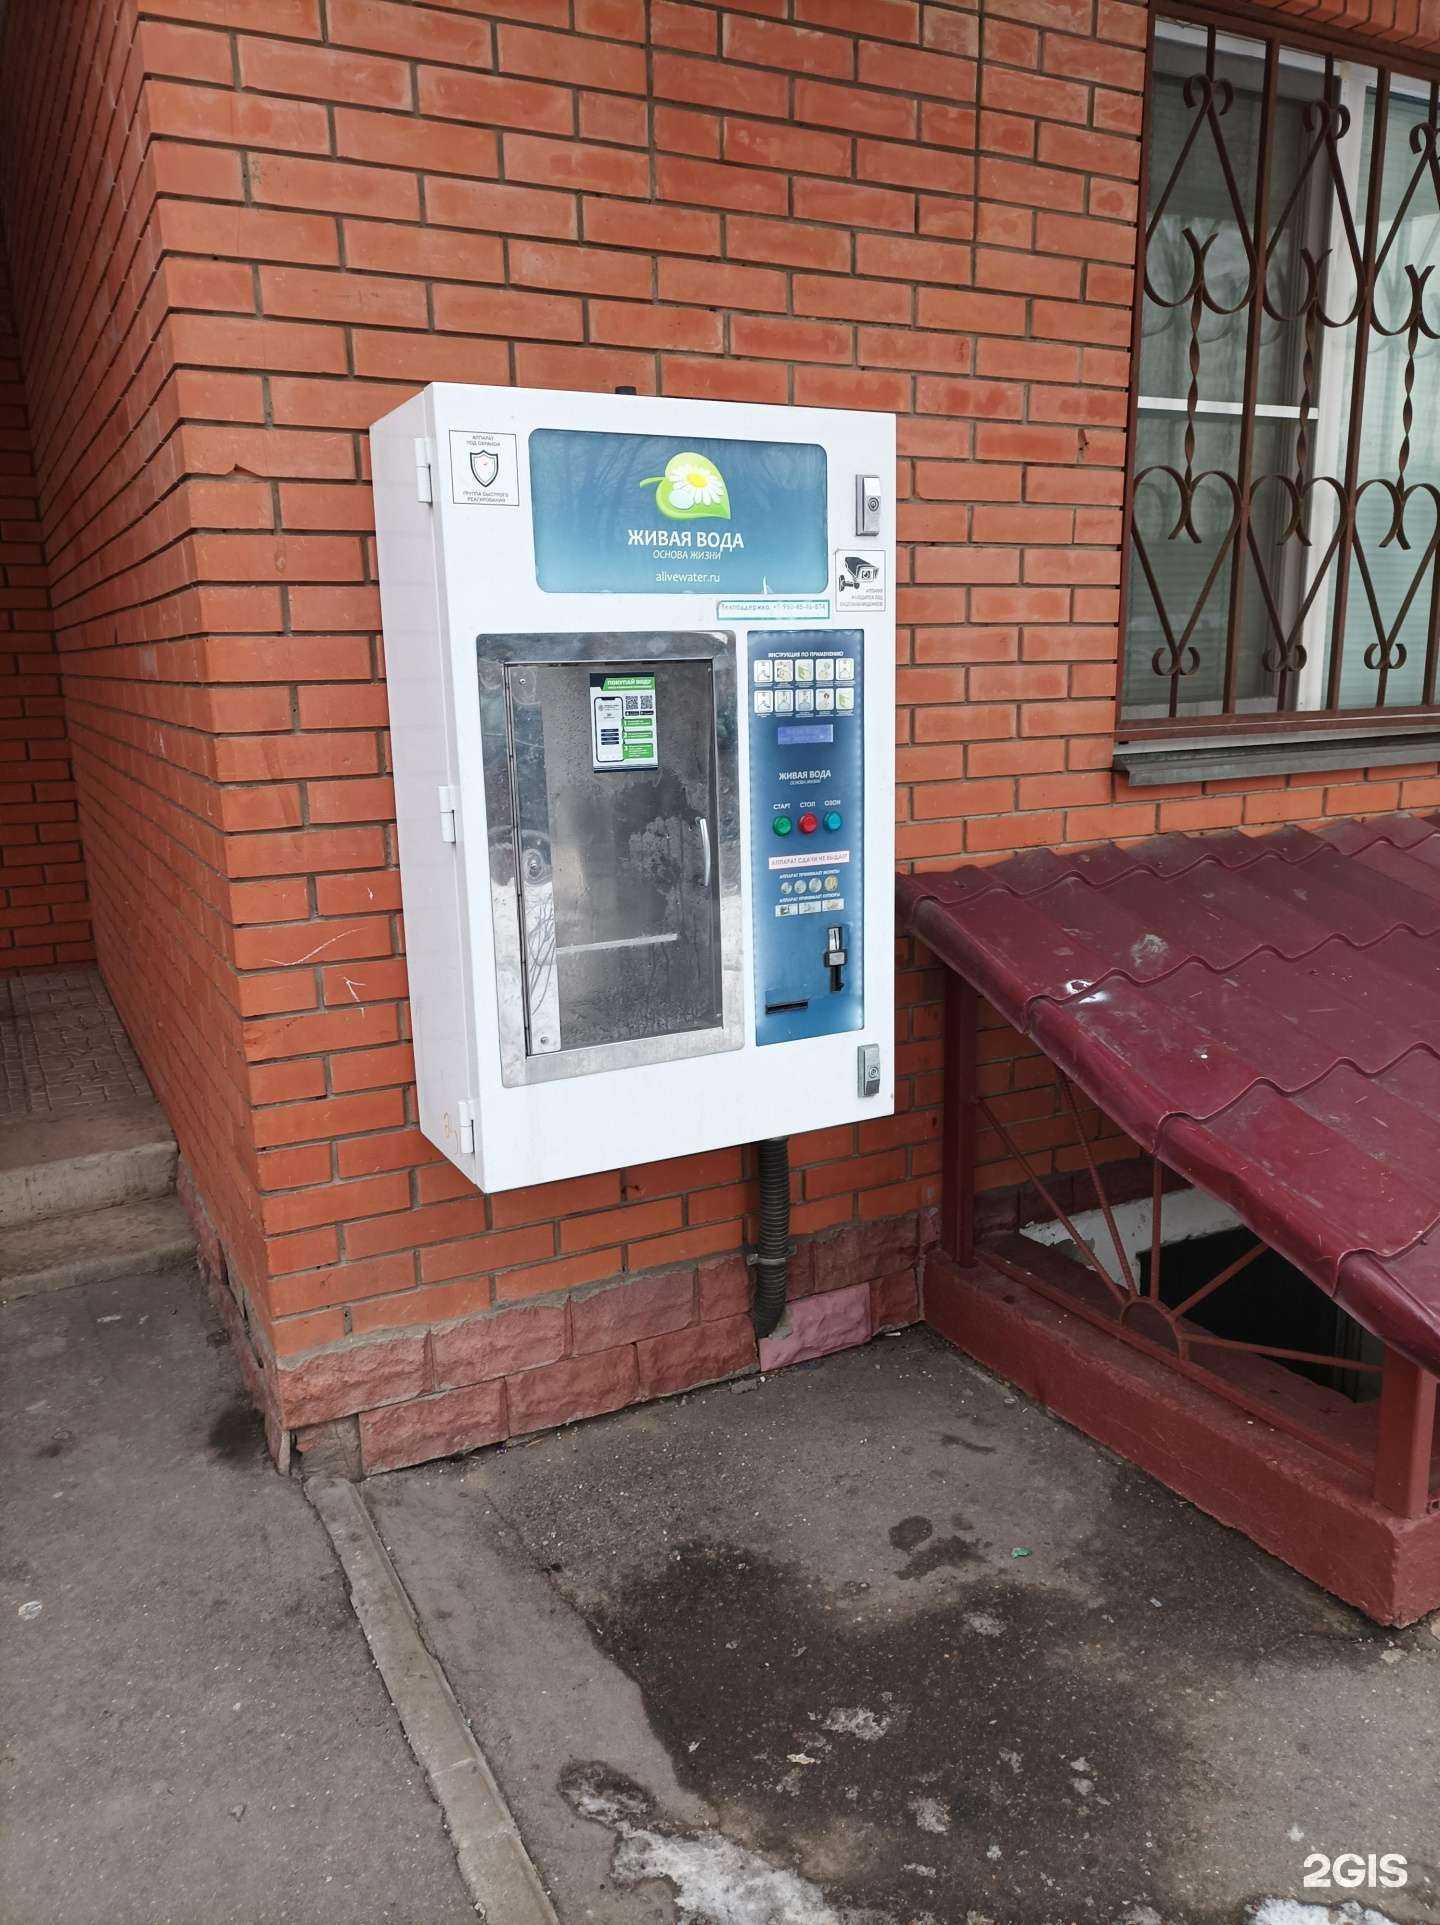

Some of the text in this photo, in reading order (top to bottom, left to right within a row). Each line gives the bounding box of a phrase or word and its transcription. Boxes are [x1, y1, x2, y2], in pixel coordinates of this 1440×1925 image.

[627, 529, 745, 552] ЖИВАЯ ВОДА
[653, 550, 721, 560] ОСНОВА ЖИЗНИ
[655, 570, 721, 583] alivewater.ru
[607, 678, 635, 686] ПОКУПАЙ
[779, 769, 832, 780] ЖИВАЯ ВОДА
[771, 857, 796, 865] АППАРАТ
[798, 856, 817, 864] СДАЧИ
